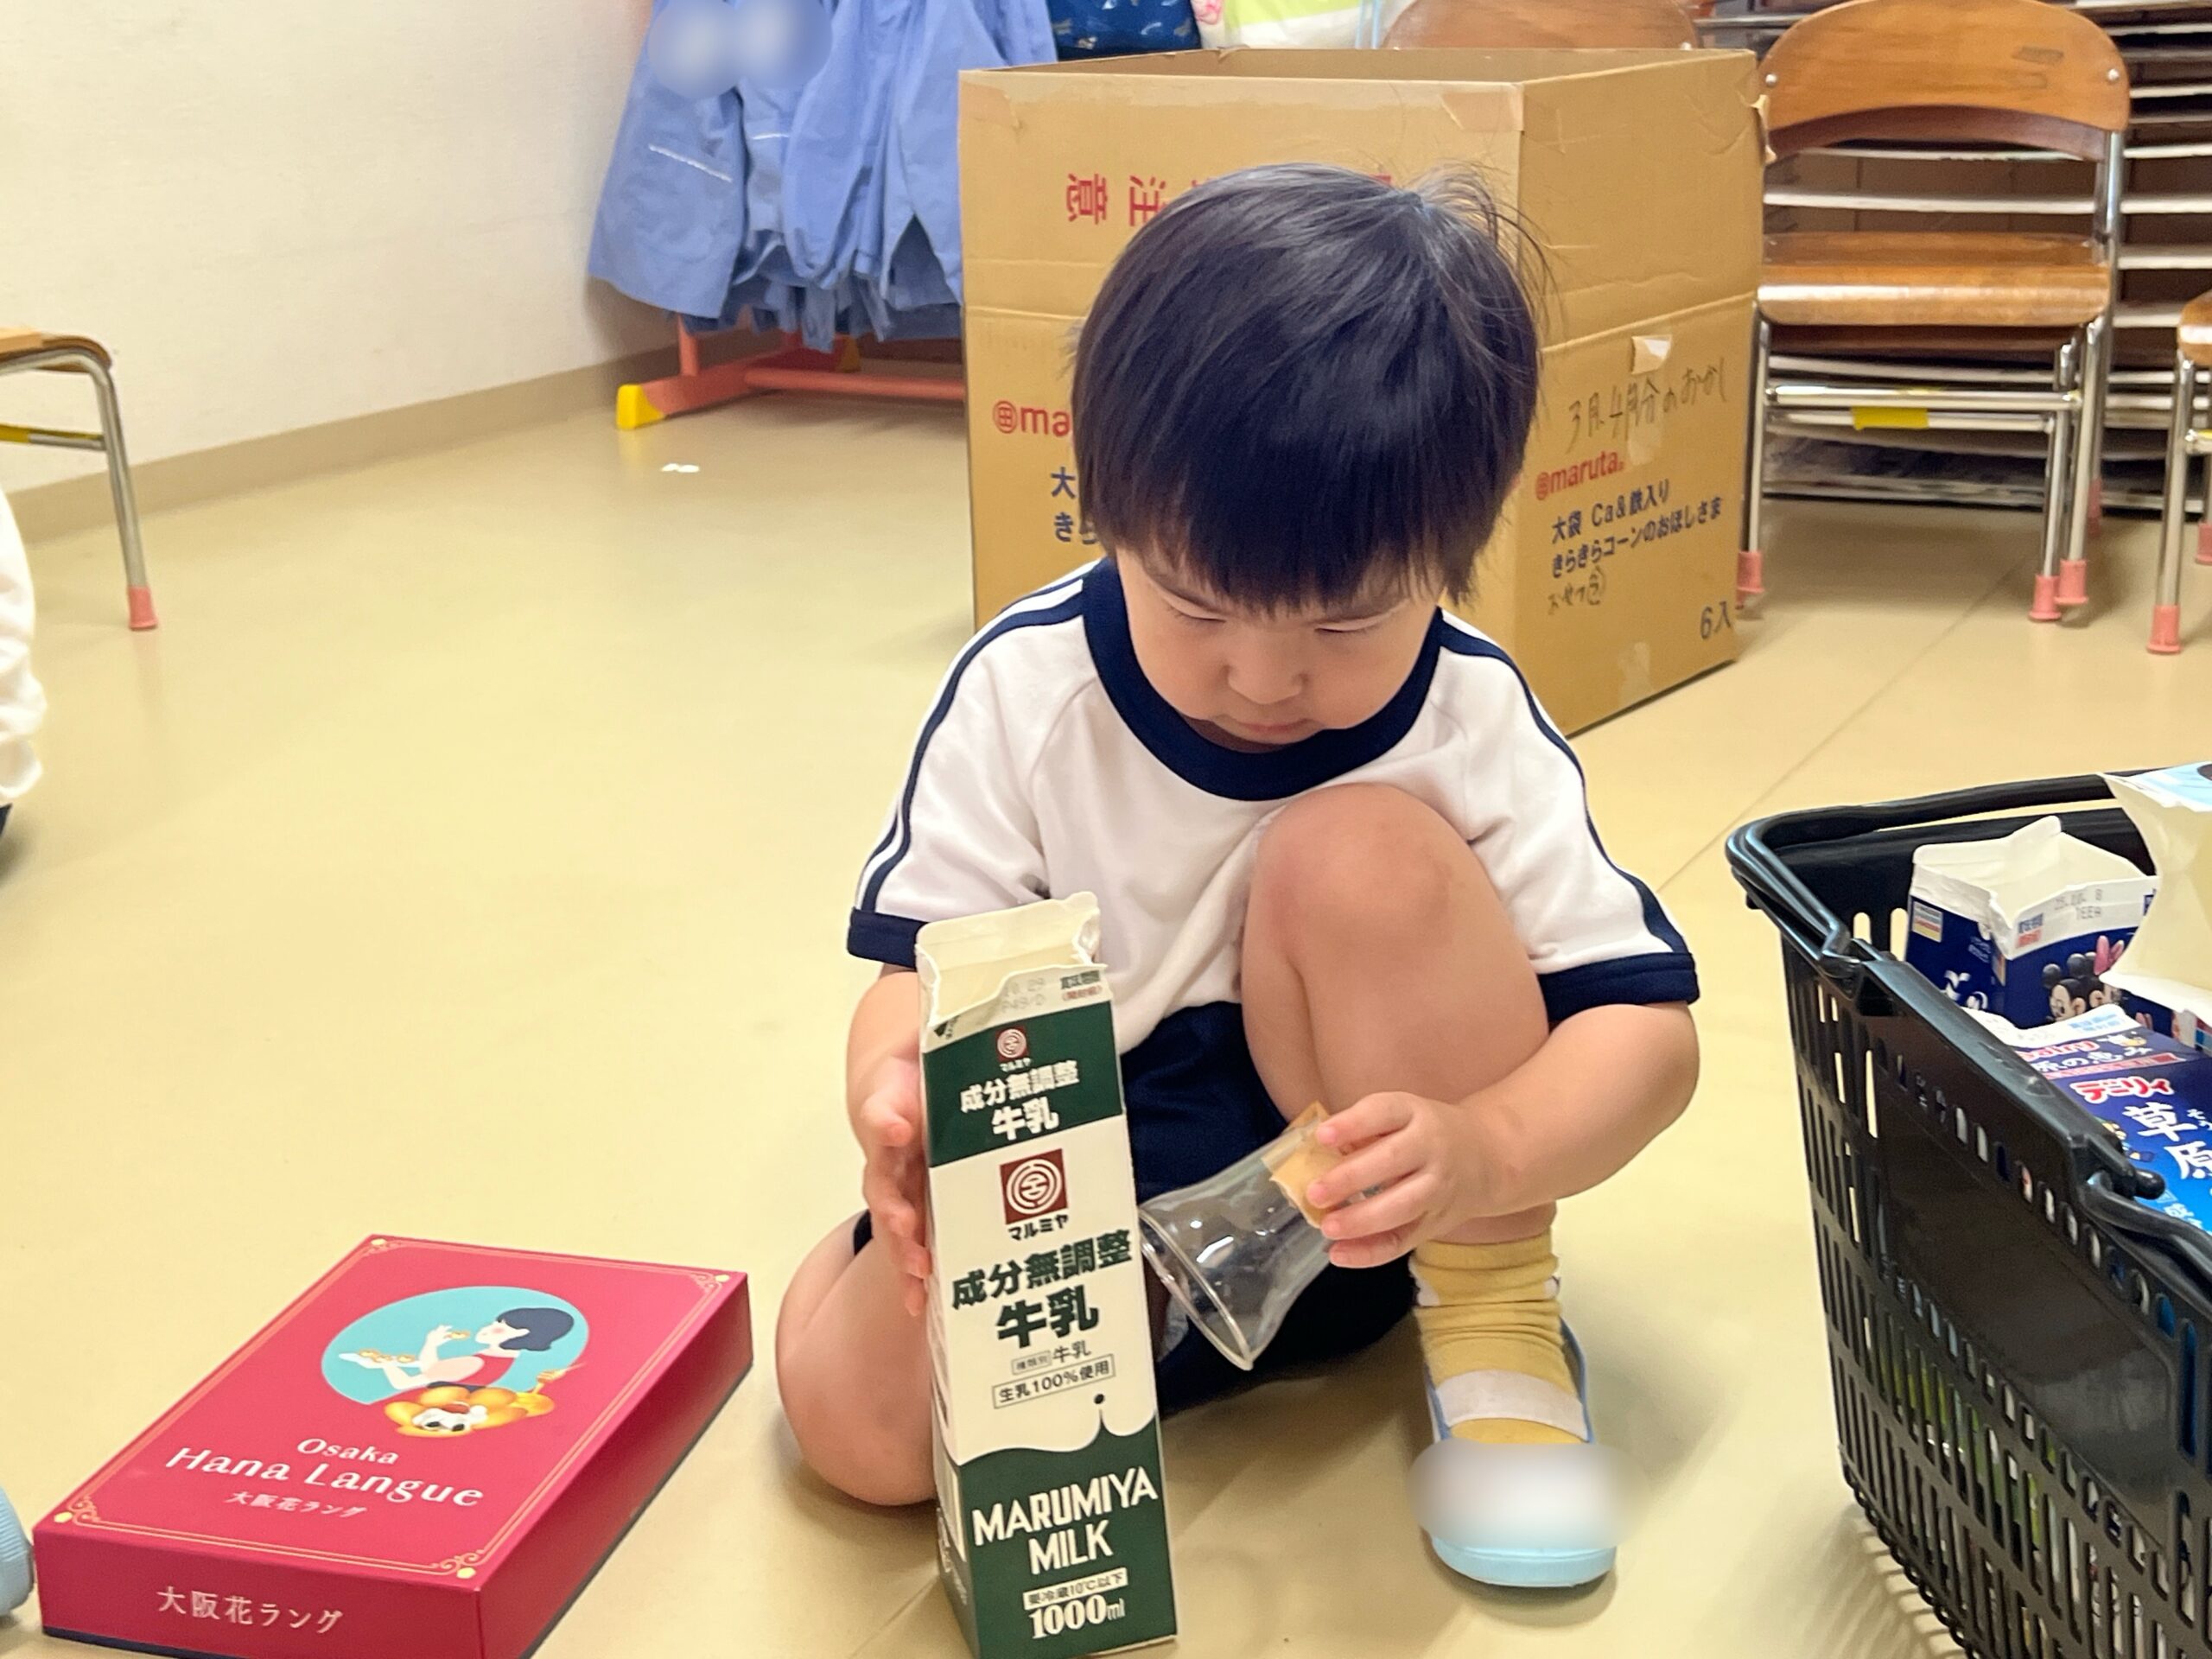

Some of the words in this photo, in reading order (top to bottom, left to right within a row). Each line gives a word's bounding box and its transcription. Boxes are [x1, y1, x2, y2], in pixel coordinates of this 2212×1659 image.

[1051, 466, 1077, 499] 大
[959, 1059, 1080, 1114] 成分無調整
[991, 1096, 1060, 1141] 牛乳
[1007, 1213, 1070, 1242] マルミヤ
[951, 1229, 1133, 1311] 成分無調整
[995, 1283, 1100, 1349] 牛乳
[1052, 1340, 1091, 1363] 牛乳
[998, 1359, 1111, 1403] 生乳100%使用
[296, 1437, 400, 1465] Osaka
[165, 1446, 291, 1482] Hana
[303, 1462, 485, 1508] Langue
[223, 1490, 369, 1519] 大阪花ラング
[971, 1465, 1160, 1547] MARUMIYA
[1027, 1519, 1114, 1575] MILK
[156, 1585, 344, 1634] 大阪花ラング
